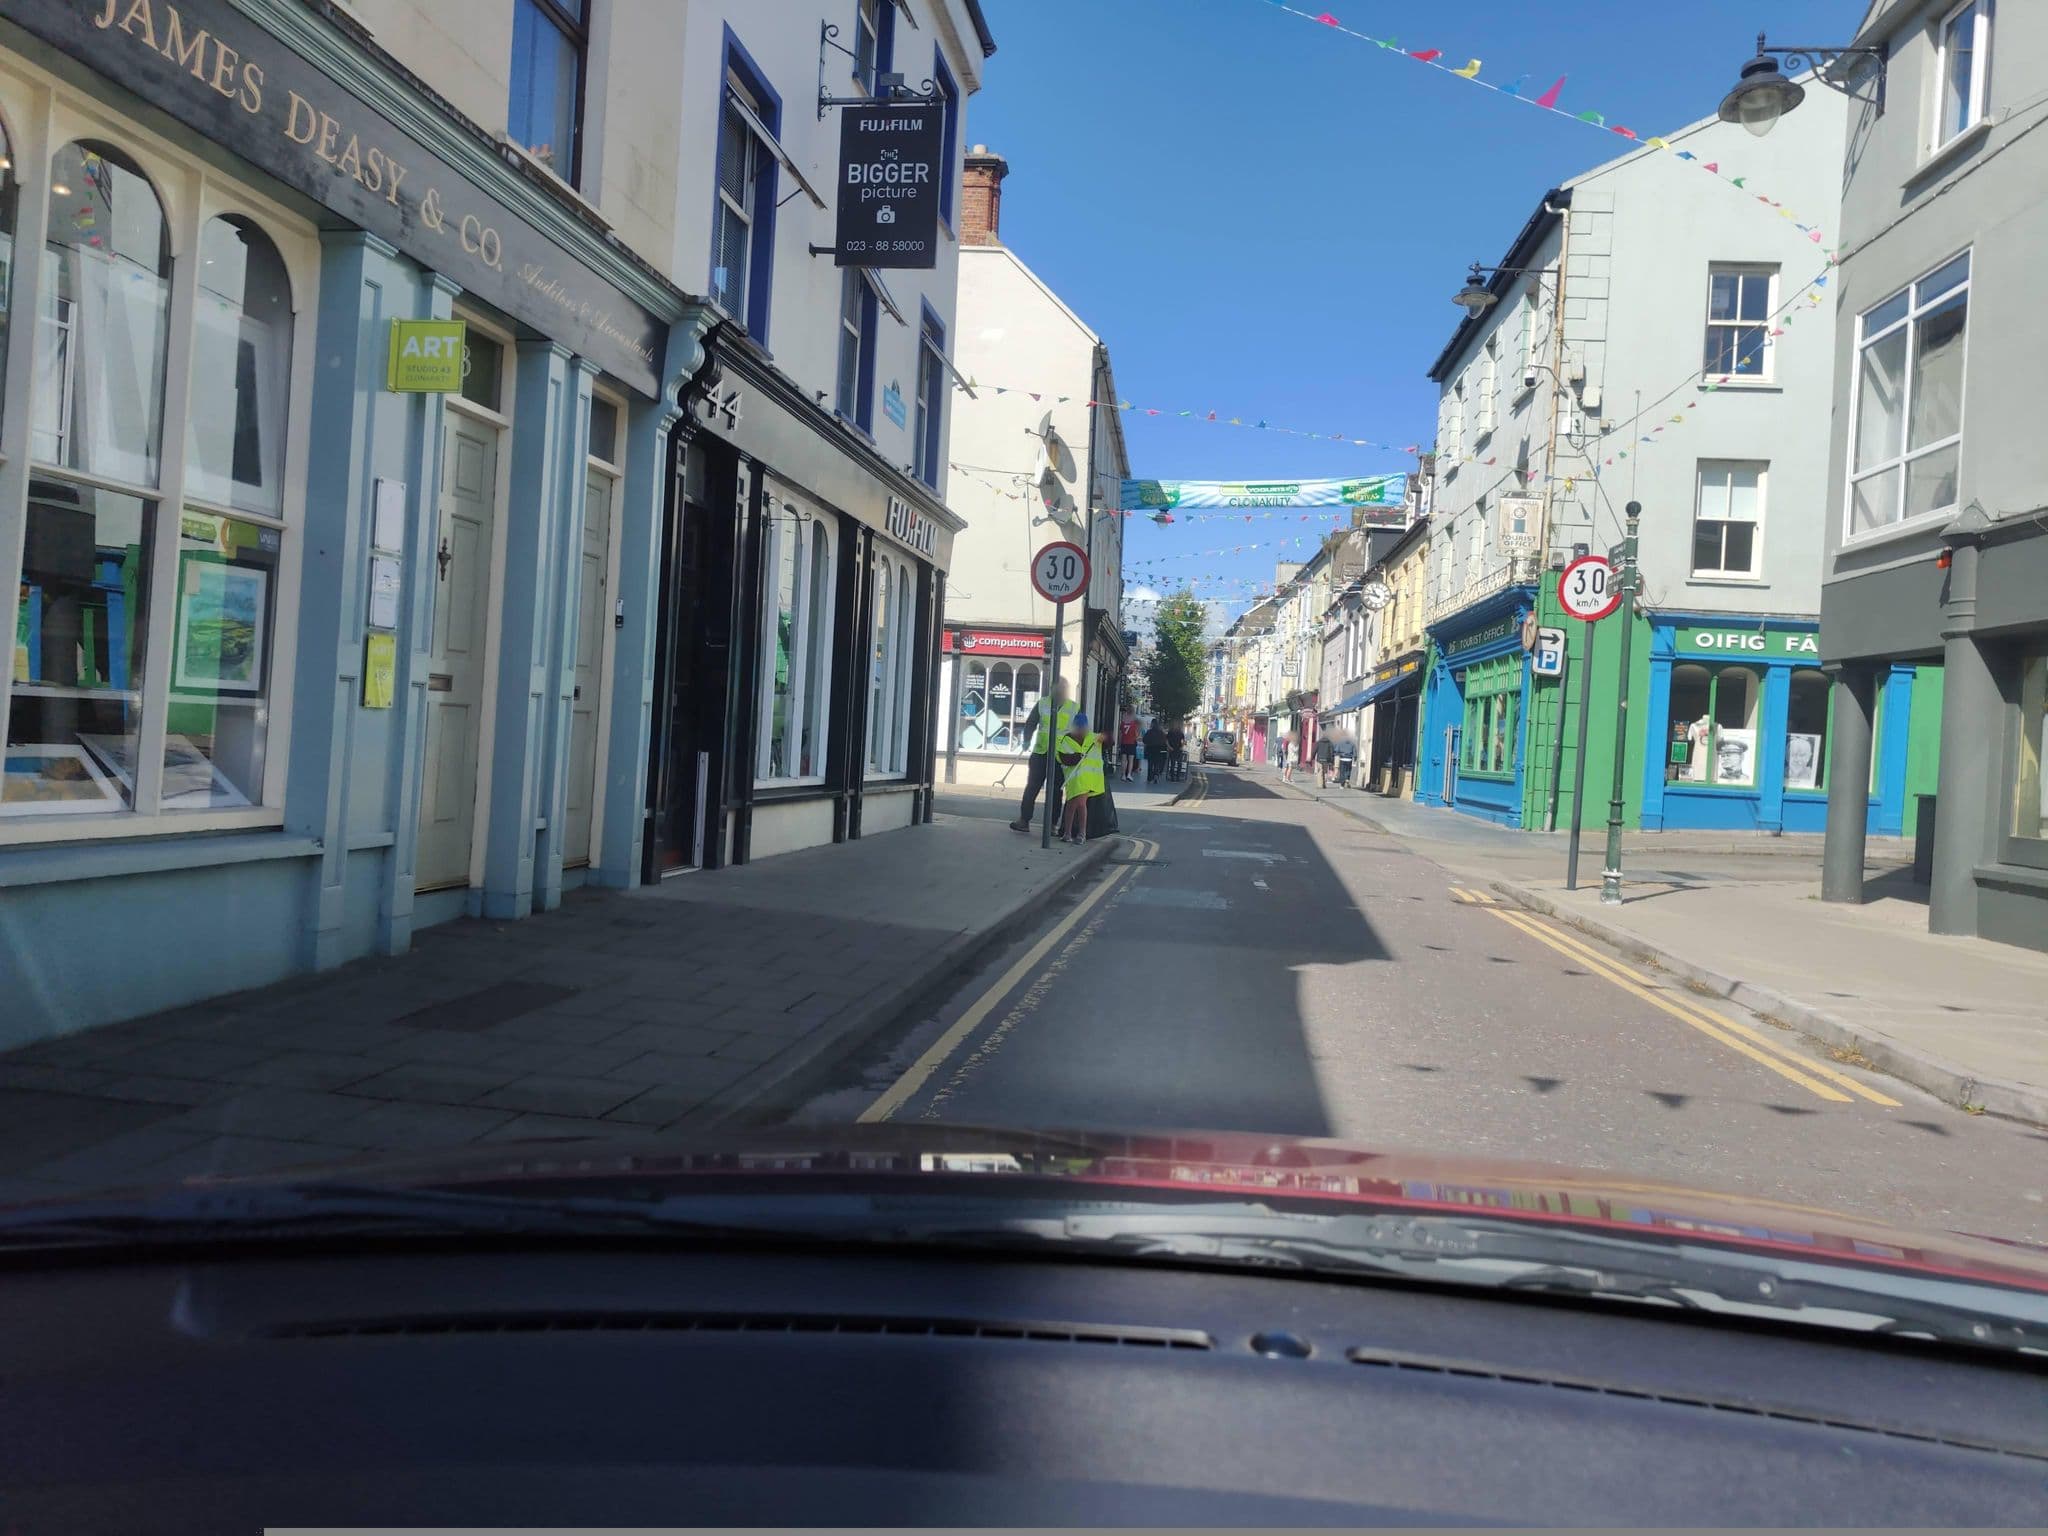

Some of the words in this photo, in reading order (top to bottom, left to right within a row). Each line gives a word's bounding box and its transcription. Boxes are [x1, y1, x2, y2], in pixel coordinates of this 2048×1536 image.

[859, 119, 923, 132] FUJIFILM
[284, 90, 408, 206] DEASY
[420, 188, 445, 235] &
[460, 214, 503, 272] CO.
[847, 163, 929, 184] BIGGER
[861, 184, 918, 203] picture
[846, 240, 866, 251] 023
[875, 240, 889, 251] 88
[891, 240, 925, 251] 58000
[402, 335, 459, 359] ART
[706, 379, 744, 431] 44
[1229, 496, 1291, 507] CLONAKILTY
[887, 496, 938, 560] FUJIFILM
[1046, 555, 1076, 580] 30
[1048, 582, 1070, 592] km/h
[1573, 568, 1605, 595] 30
[1576, 597, 1600, 609] km/h
[978, 637, 1043, 649] computronic
[1460, 633, 1482, 649] TOURIST
[1483, 623, 1505, 641] OFFICE
[1695, 632, 1765, 651] OIFIG
[1541, 650, 1556, 668] P
[1123, 724, 1132, 735] 7
